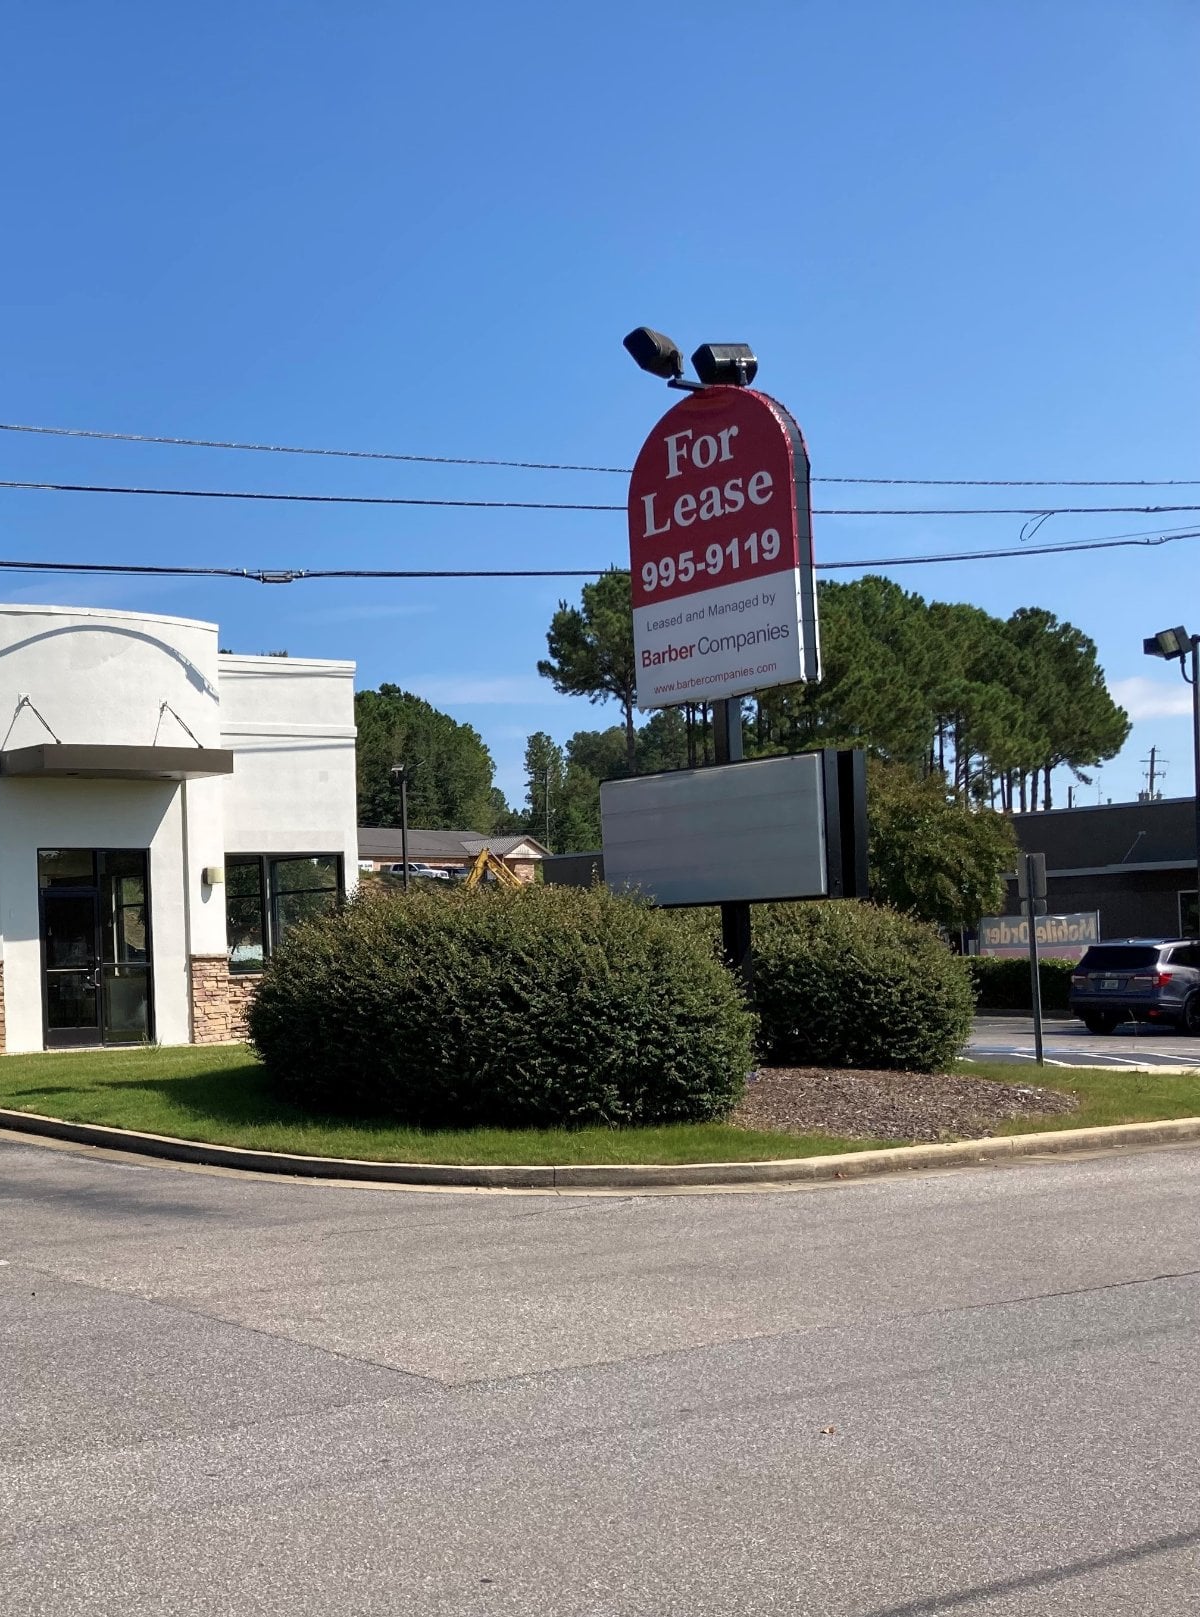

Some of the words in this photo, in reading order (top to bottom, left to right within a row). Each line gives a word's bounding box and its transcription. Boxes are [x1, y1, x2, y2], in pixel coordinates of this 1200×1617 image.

[664, 425, 739, 480] For
[640, 470, 773, 538] Lease
[641, 528, 781, 592] 995-9119
[646, 613, 682, 632] Leased
[685, 608, 705, 623] and
[708, 595, 759, 617] Managed
[762, 592, 776, 606] by
[641, 642, 696, 668] Barber
[697, 623, 790, 656] Companies
[653, 662, 777, 695] www.barbercompanies.com
